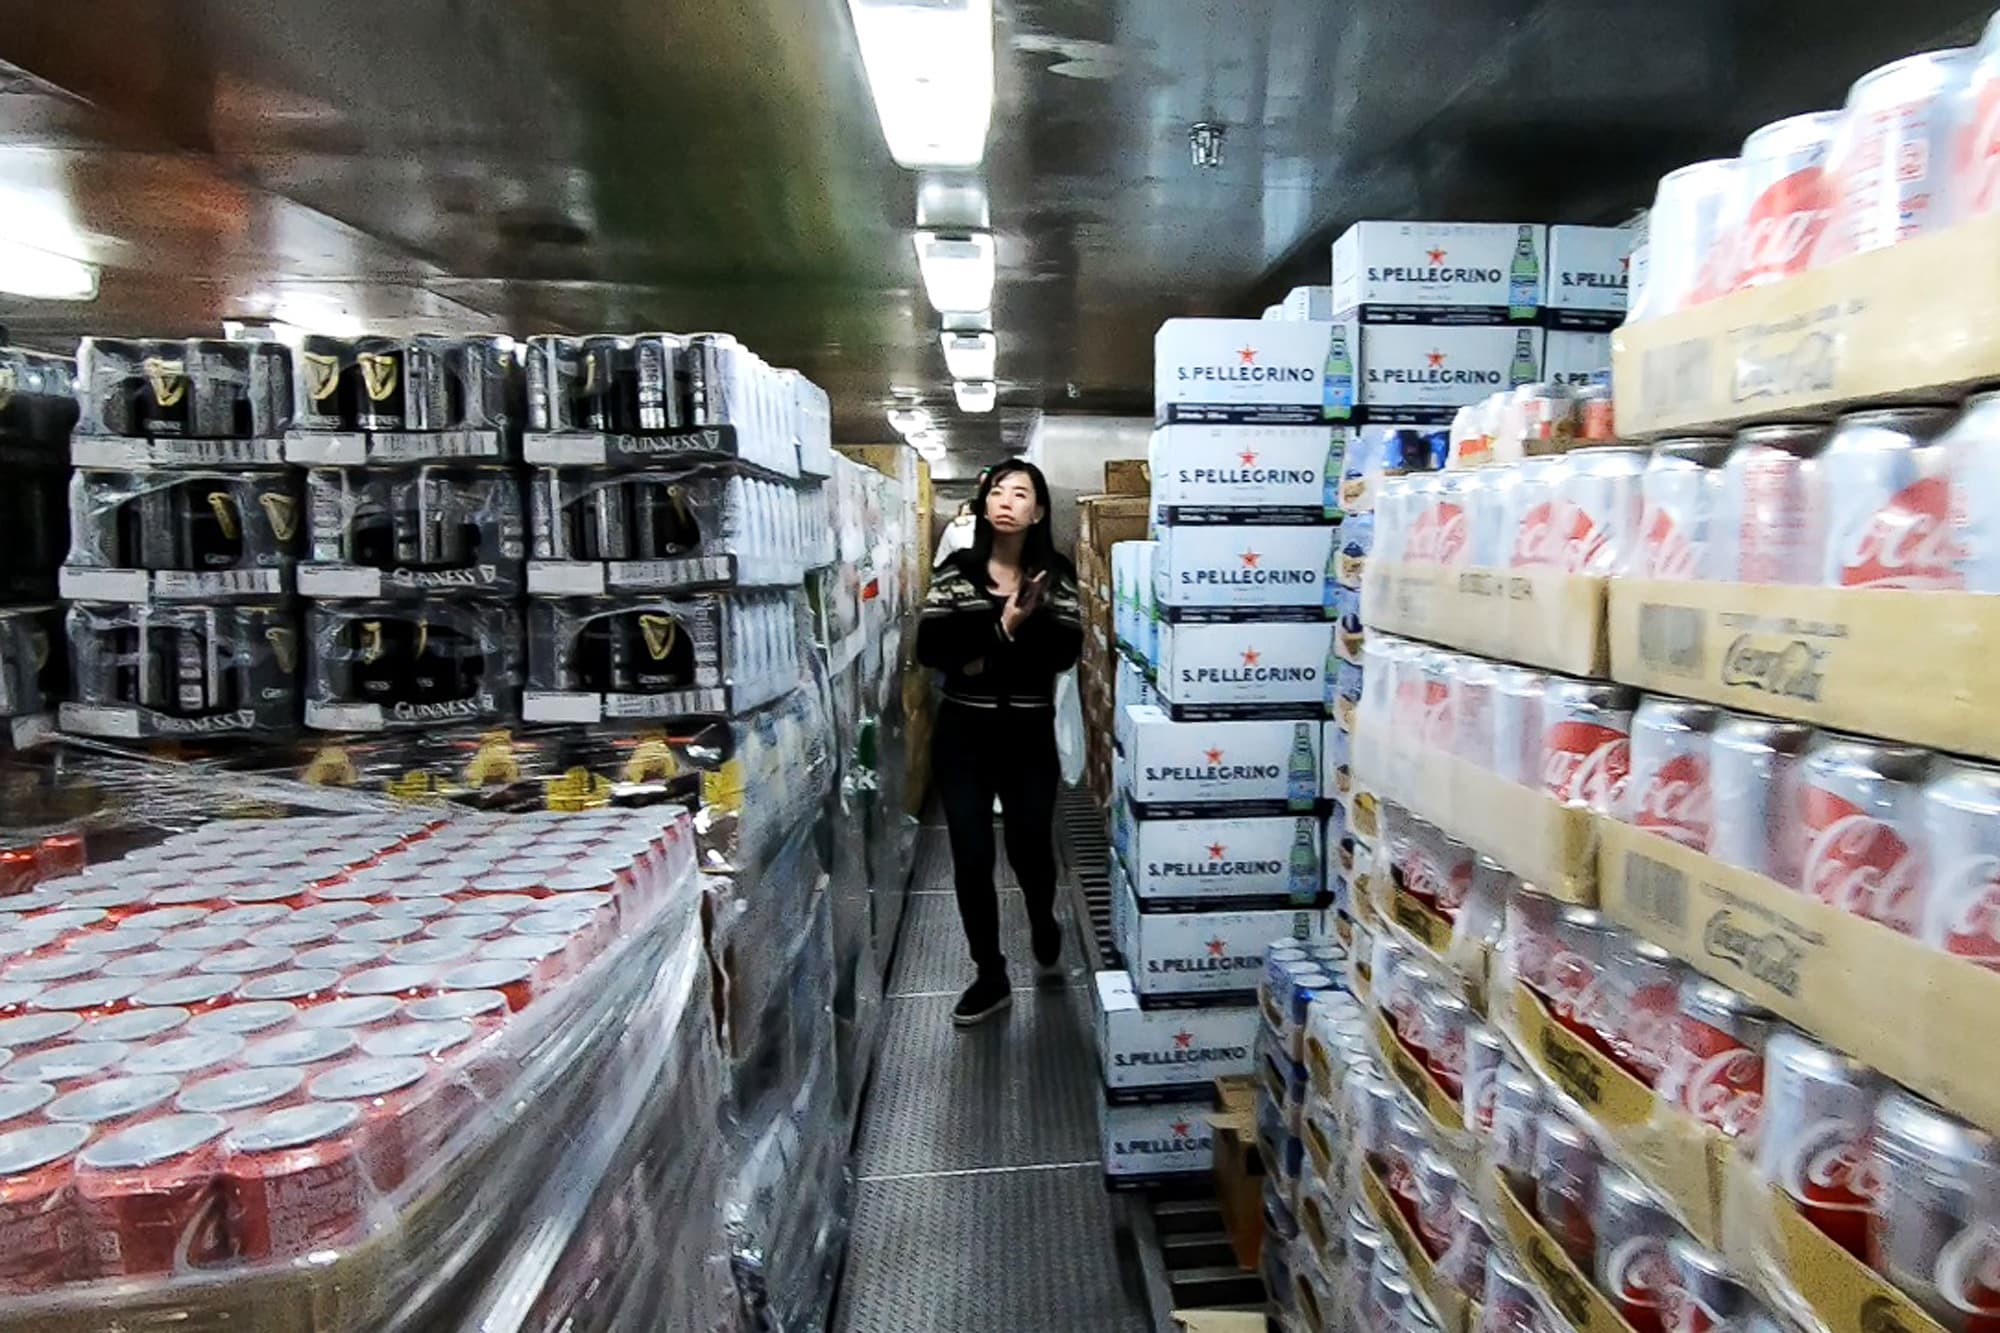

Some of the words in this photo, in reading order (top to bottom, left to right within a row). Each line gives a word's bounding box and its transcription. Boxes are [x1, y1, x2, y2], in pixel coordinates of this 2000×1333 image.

[1368, 267, 1502, 283] S.PELLEGRINO
[1561, 271, 1629, 288] S.PELLE
[1177, 367, 1315, 382] S.PELLEGRINO
[1368, 369, 1501, 384] S.PELLEGRINO
[1179, 469, 1316, 484] S.PELLEGRINO
[1181, 570, 1317, 585] S.PELLEGRINO
[1181, 667, 1317, 683] S.PELLEGRINO
[1145, 764, 1280, 782] S.PELLEGRINO
[1147, 860, 1283, 877] S.PELLEGRINO
[1147, 956, 1264, 974] S.PELLEGRIN
[1113, 1137, 1213, 1155] S.PELLEGR
